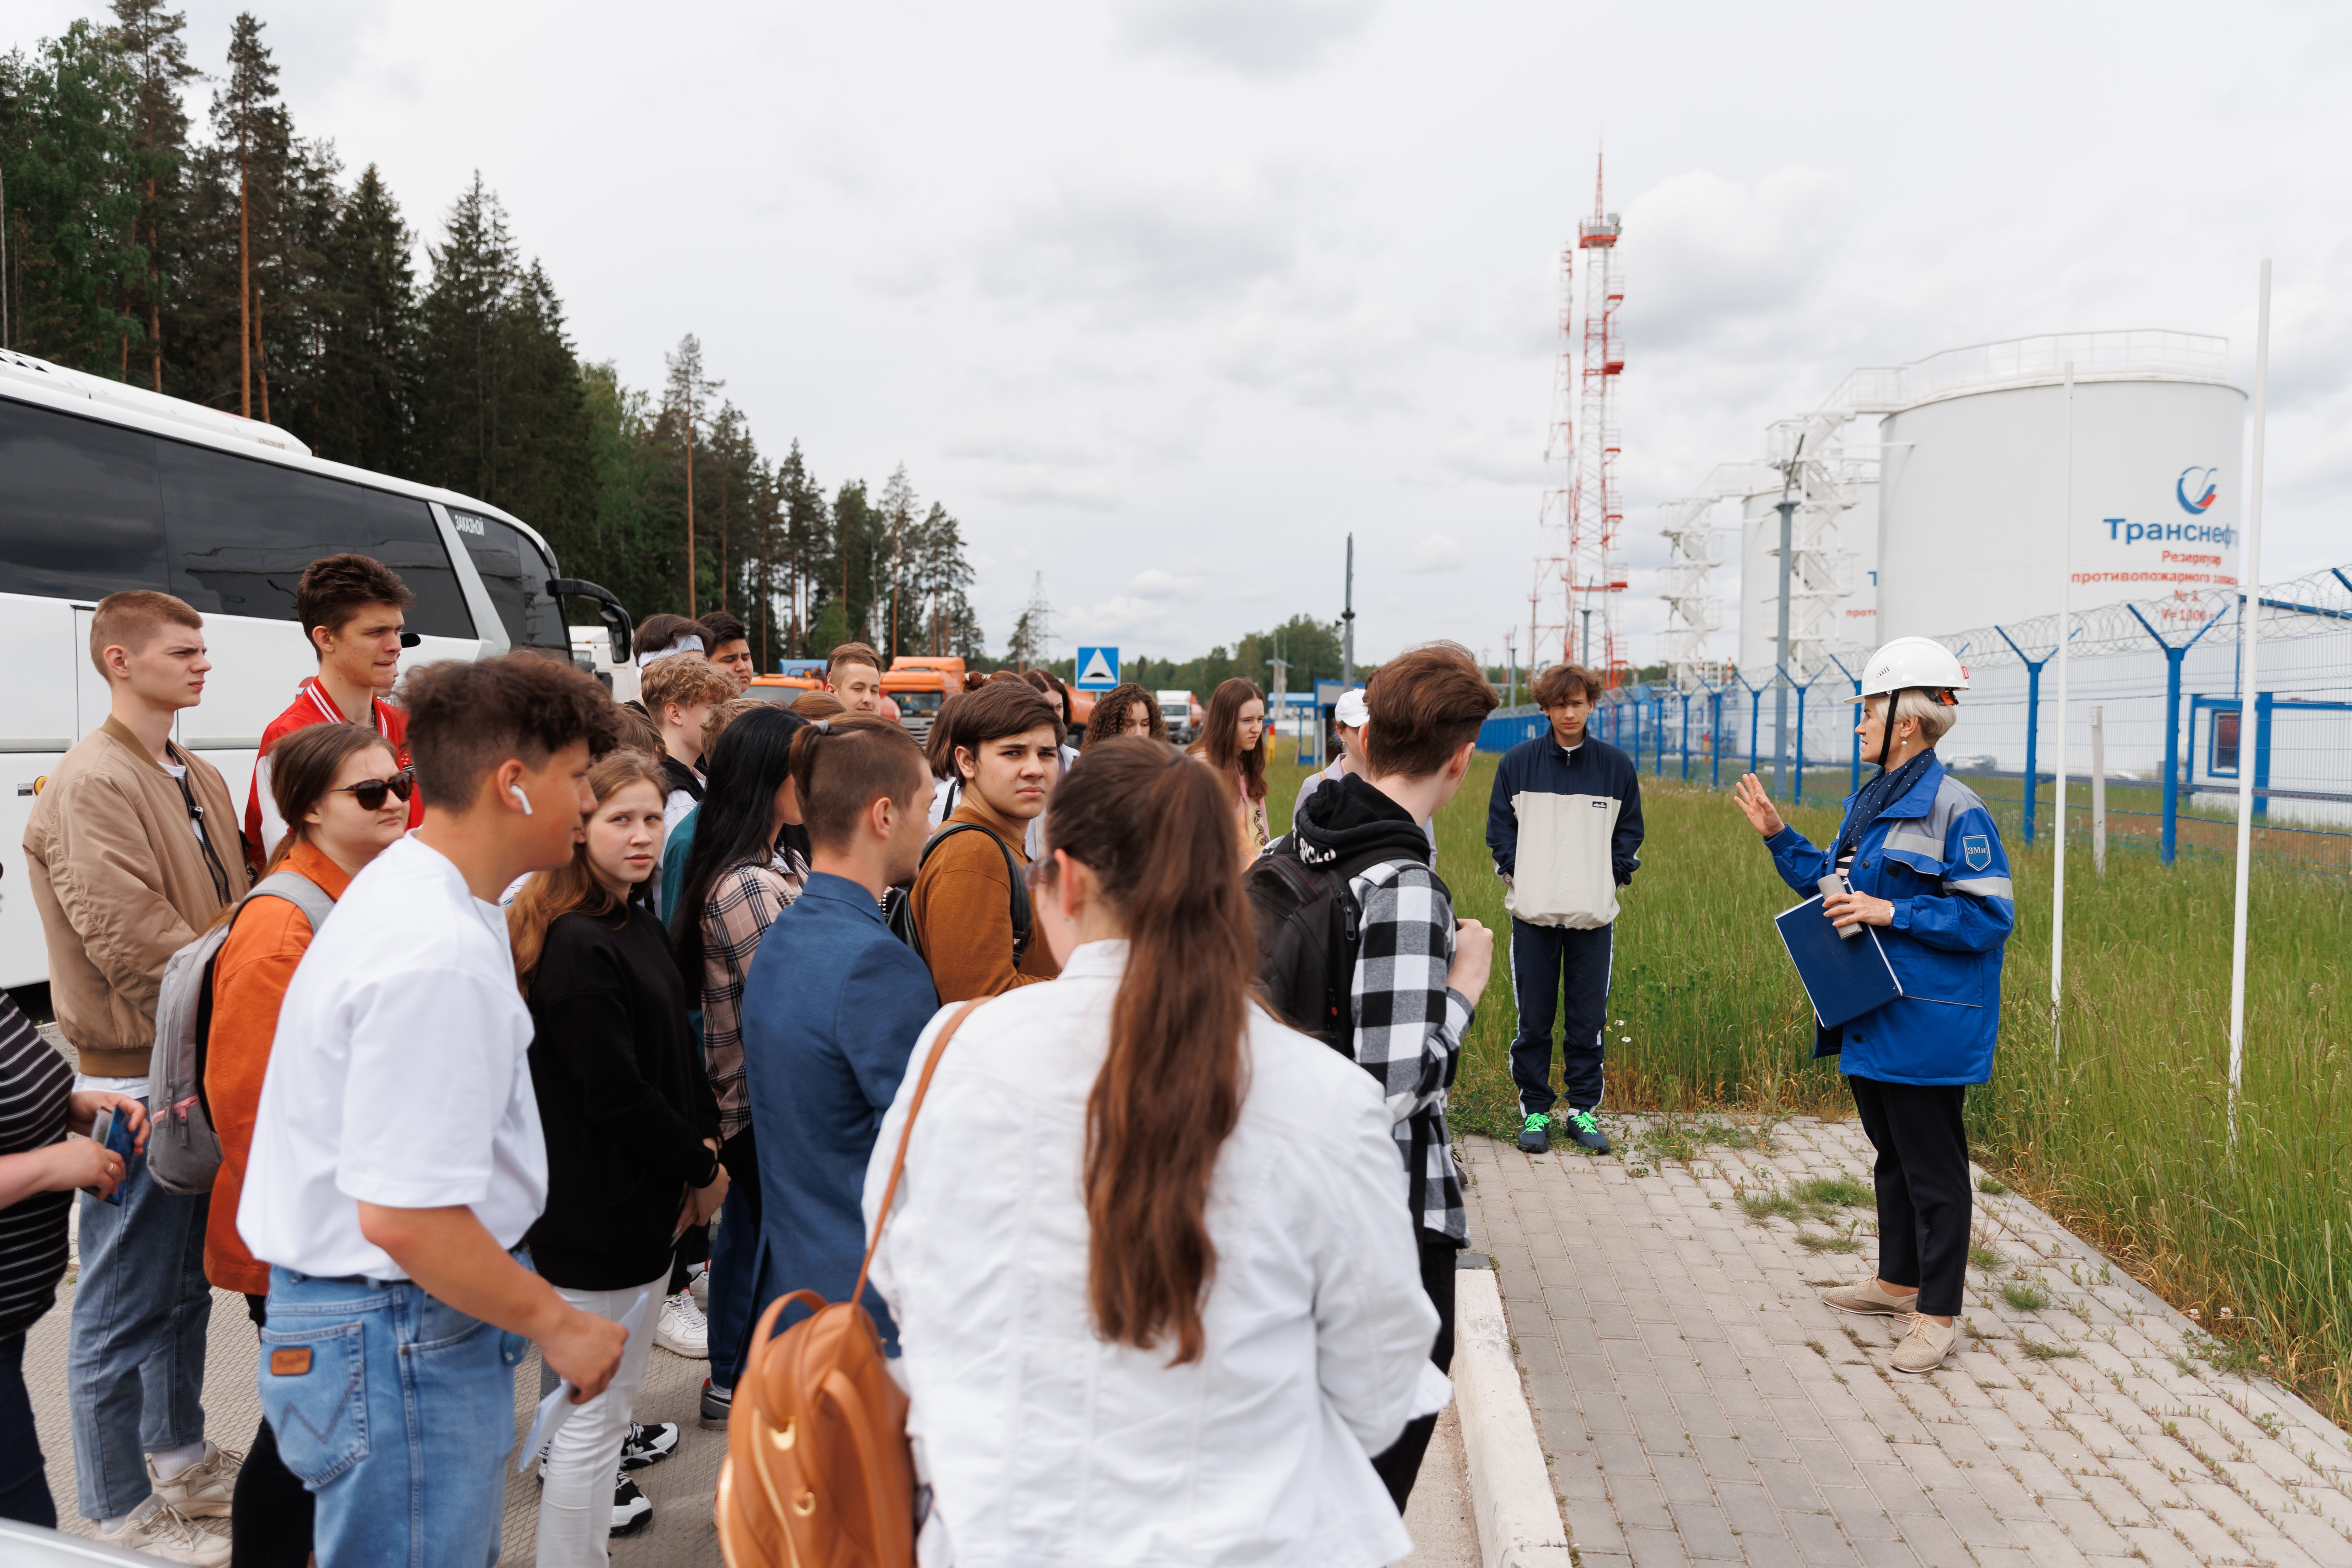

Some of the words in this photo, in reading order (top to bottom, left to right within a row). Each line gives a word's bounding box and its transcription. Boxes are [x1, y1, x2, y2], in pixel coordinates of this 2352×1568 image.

[454, 514, 485, 536] ЗАКАЗНОЙ
[2162, 550, 2221, 566] Резервуар
[2071, 571, 2210, 584] противопожарного
